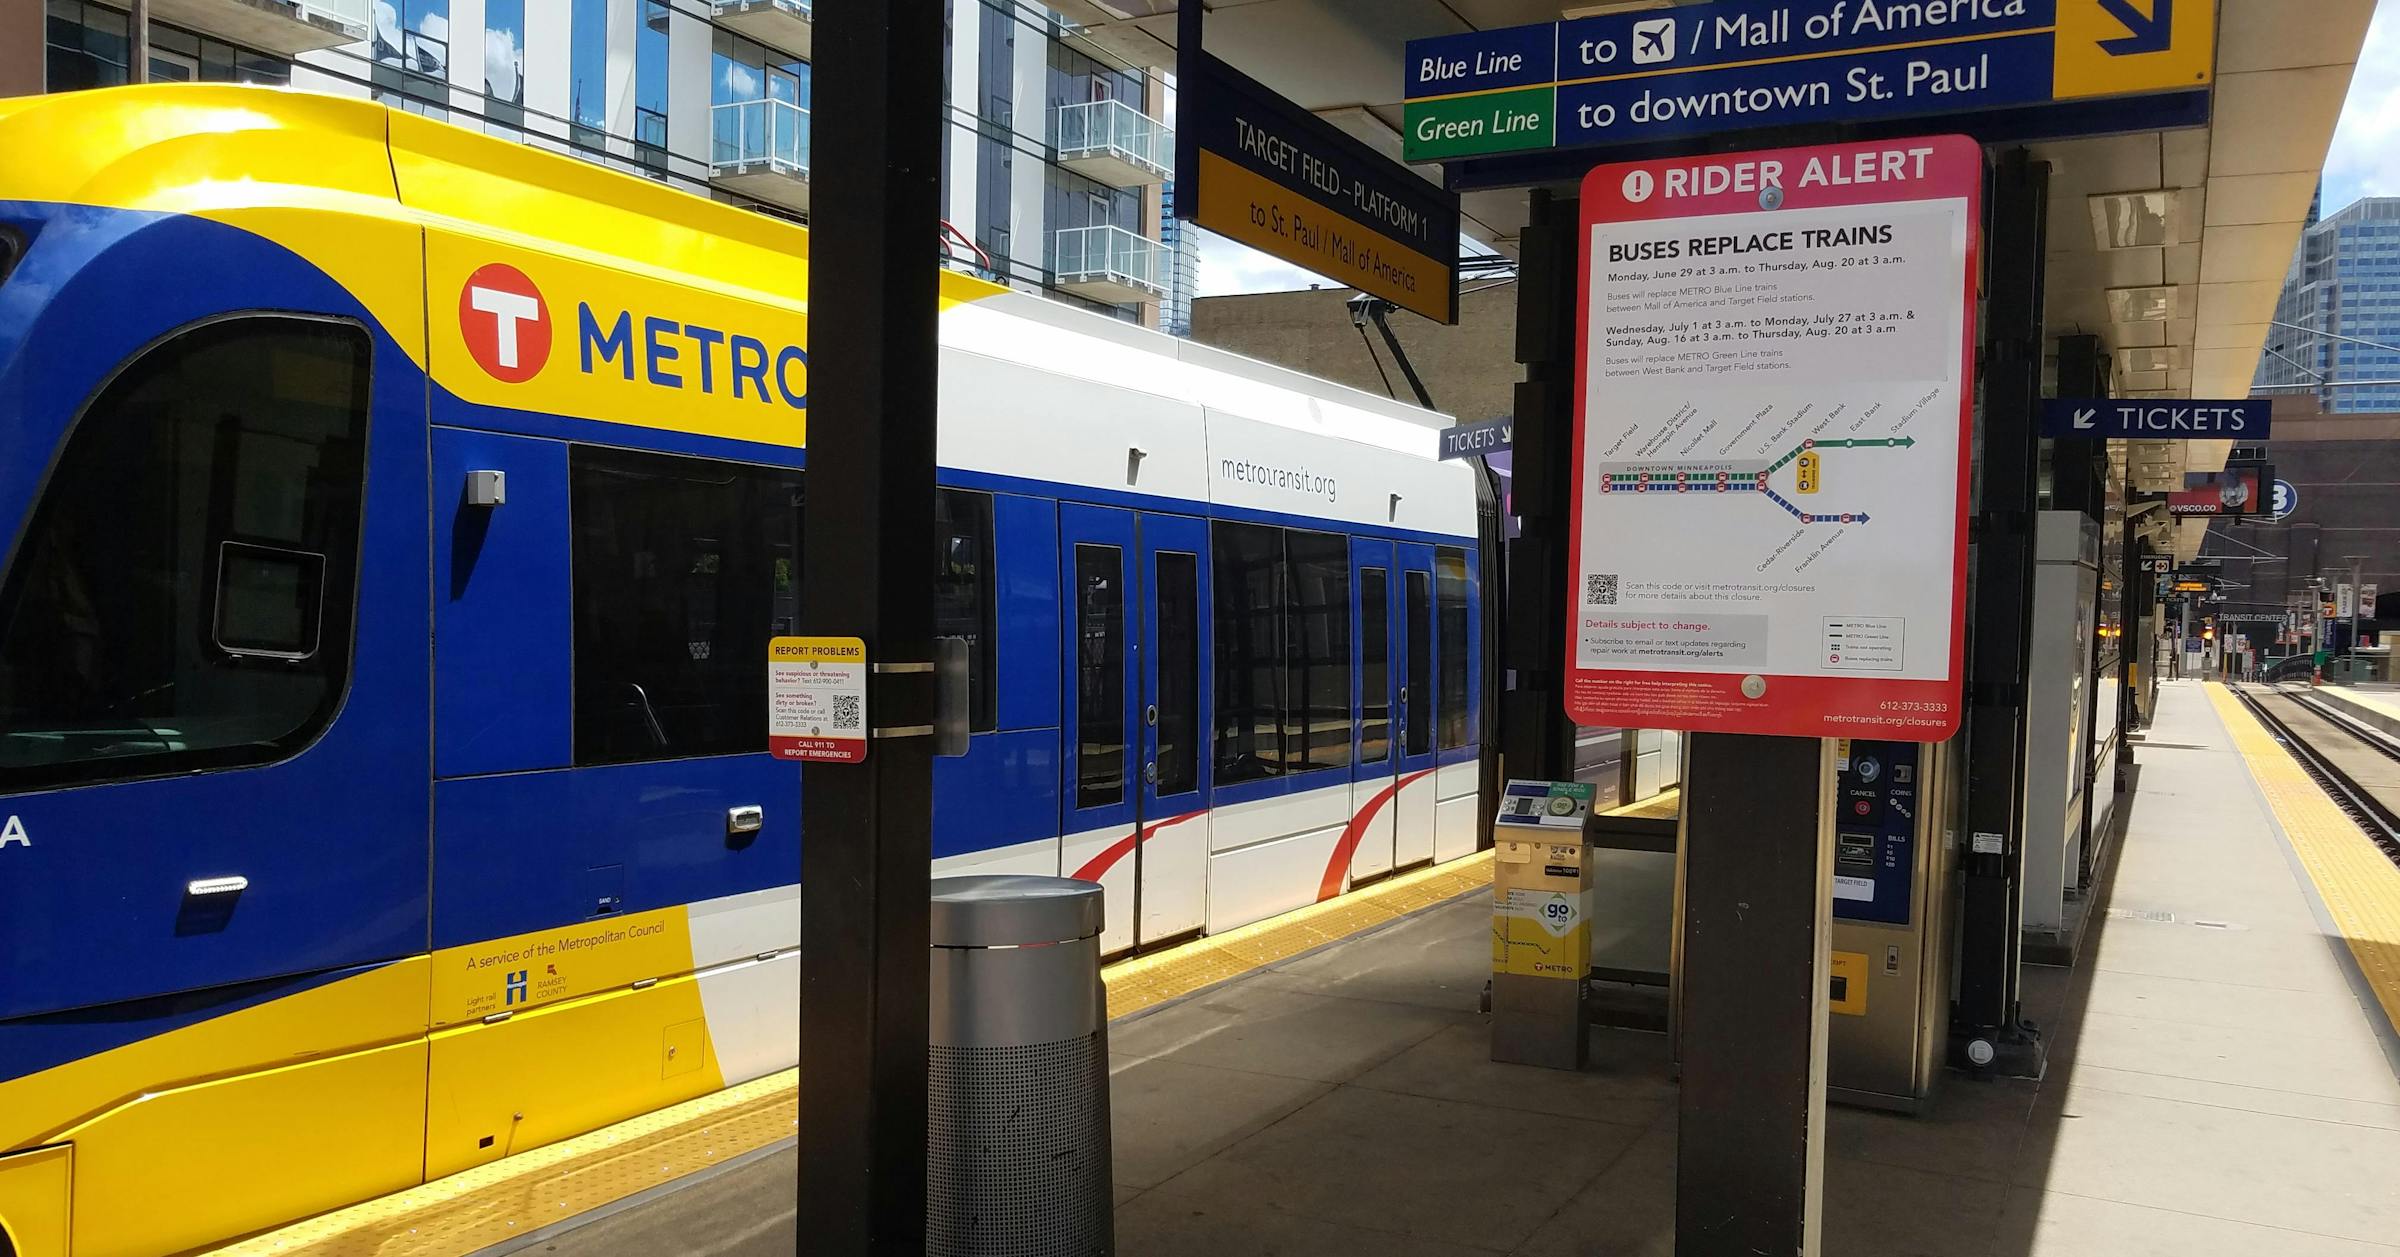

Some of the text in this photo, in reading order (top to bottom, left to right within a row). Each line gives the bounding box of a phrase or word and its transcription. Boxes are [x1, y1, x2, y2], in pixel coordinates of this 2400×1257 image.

[1579, 0, 2026, 65] to / Mall of America
[1419, 51, 1522, 82] Blue Line
[1577, 54, 1988, 129] to downtown St. Paul
[1416, 110, 1540, 142] Green Line
[1235, 117, 1298, 174] TARGET
[1302, 153, 1340, 195] FIELD
[1354, 180, 1418, 237] PLATFORM
[1422, 216, 1428, 241] 1
[1664, 146, 1933, 197] RIDER ALERT
[1250, 201, 1416, 293] to St. Paul / Mall of America
[1609, 224, 1892, 262] BUSES REPLACE TRAINS
[1608, 271, 1649, 282] Monday,
[1652, 270, 1676, 278] June
[1680, 268, 1692, 276] 29
[1709, 266, 1715, 274] 3
[1758, 260, 1808, 272] Thursday,
[1812, 259, 1836, 269] Aug.
[1841, 257, 1854, 266] 20
[1858, 257, 1868, 265] at
[1872, 255, 1878, 264] 3
[1644, 301, 1660, 310] Mall
[1663, 300, 1672, 309] of
[1709, 297, 1725, 306] and
[1727, 297, 1754, 306] Target
[1757, 294, 1777, 303] Field
[1780, 293, 1814, 302] stations.
[1647, 289, 1676, 298] replace
[1679, 286, 1711, 295] METRO
[1714, 285, 1732, 293] Blue
[1735, 284, 1752, 292] Line
[1754, 282, 1777, 291] trains
[1606, 324, 1665, 334] Wednesday,
[1668, 321, 1689, 333] July
[1693, 321, 1696, 329] 1
[1715, 320, 1721, 328] 3
[1765, 315, 1809, 326] Monday,
[1813, 313, 1834, 325] July
[1838, 313, 1851, 322] 27
[1868, 312, 1875, 321] 3
[1906, 310, 1914, 319] &
[1606, 336, 1643, 347] Sunday,
[1646, 336, 1669, 346] Aug.
[1674, 334, 1686, 342] 16
[1703, 332, 1709, 341] 3
[1752, 328, 1801, 339] Thursday,
[1805, 327, 1830, 337] Aug.
[1834, 325, 1847, 334] 20
[1866, 324, 1872, 333] 3
[471, 285, 808, 410] T METRO
[1812, 402, 1846, 434] West Bank
[1850, 401, 1882, 432] East Bank
[1890, 388, 1940, 434] Stadium Village
[2116, 408, 2246, 432] TICKETS
[1448, 427, 1495, 454] TICKETS
[1604, 424, 1639, 458] Target Field
[1635, 401, 1691, 457] Warehouse District/
[1646, 408, 1698, 458] Hennepin Avenue
[1680, 419, 1718, 456] Nicollet Mall
[1719, 404, 1774, 456] Government Plaza
[1758, 402, 1814, 454] U.S. Bank Stadium
[1221, 456, 1336, 503] metrotransit.org
[1756, 528, 1804, 572] Cedar-Riverside
[1794, 528, 1844, 574] Franklin Avenue
[1585, 619, 1617, 628] Details
[1620, 620, 1655, 630] subject
[1672, 621, 1709, 632] change.
[776, 647, 860, 656] REPORT PROBLEMS
[1824, 714, 1946, 727] metrotransit.org/closures
[1880, 700, 1948, 712] 612-373-3333
[809, 750, 851, 758] EMERGENCIES
[1548, 904, 1569, 918] go
[466, 920, 665, 971] A service of the Metropolitan Council
[538, 976, 567, 989] RAMSEY
[1545, 965, 1572, 973] METRO
[467, 992, 496, 1007] Light rail
[536, 986, 567, 999] COUNTY
[466, 1004, 496, 1016] partners
